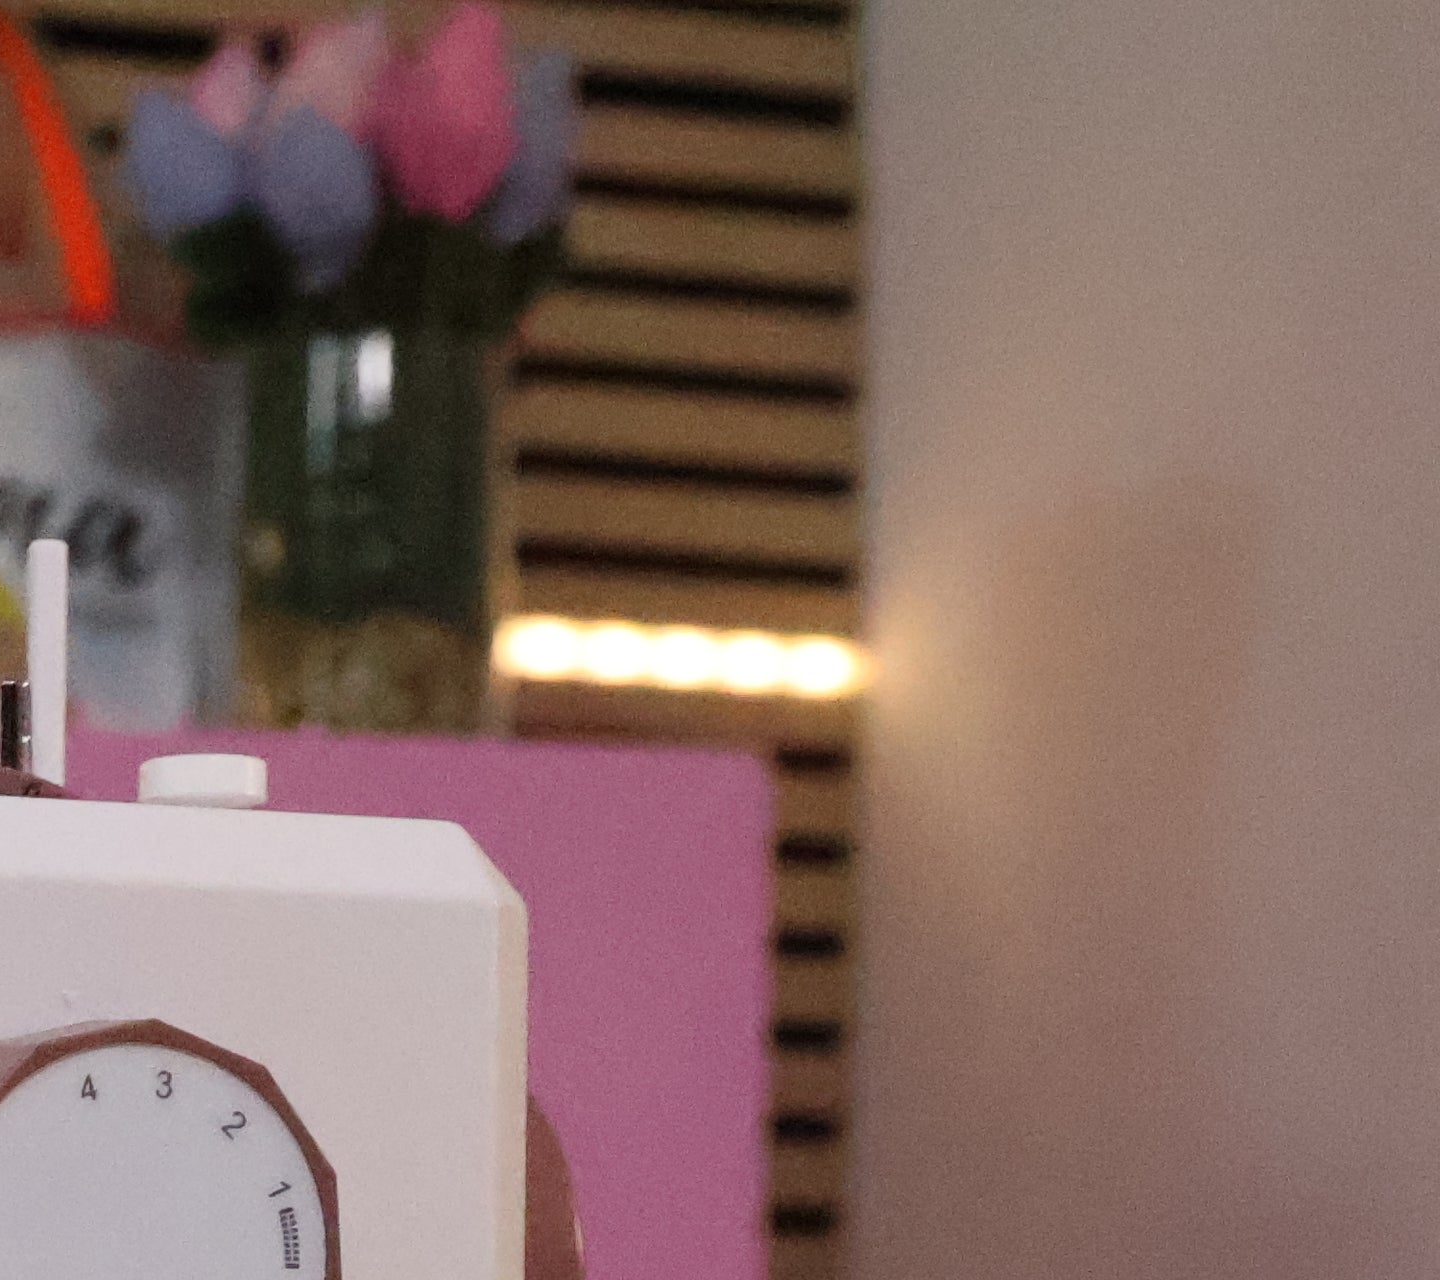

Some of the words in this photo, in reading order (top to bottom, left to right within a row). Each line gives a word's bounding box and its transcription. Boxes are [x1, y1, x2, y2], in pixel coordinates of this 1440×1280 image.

[80, 1074, 98, 1101] 4
[155, 1069, 173, 1100] 3
[220, 1110, 247, 1140] 2
[268, 1181, 292, 1198] 1
